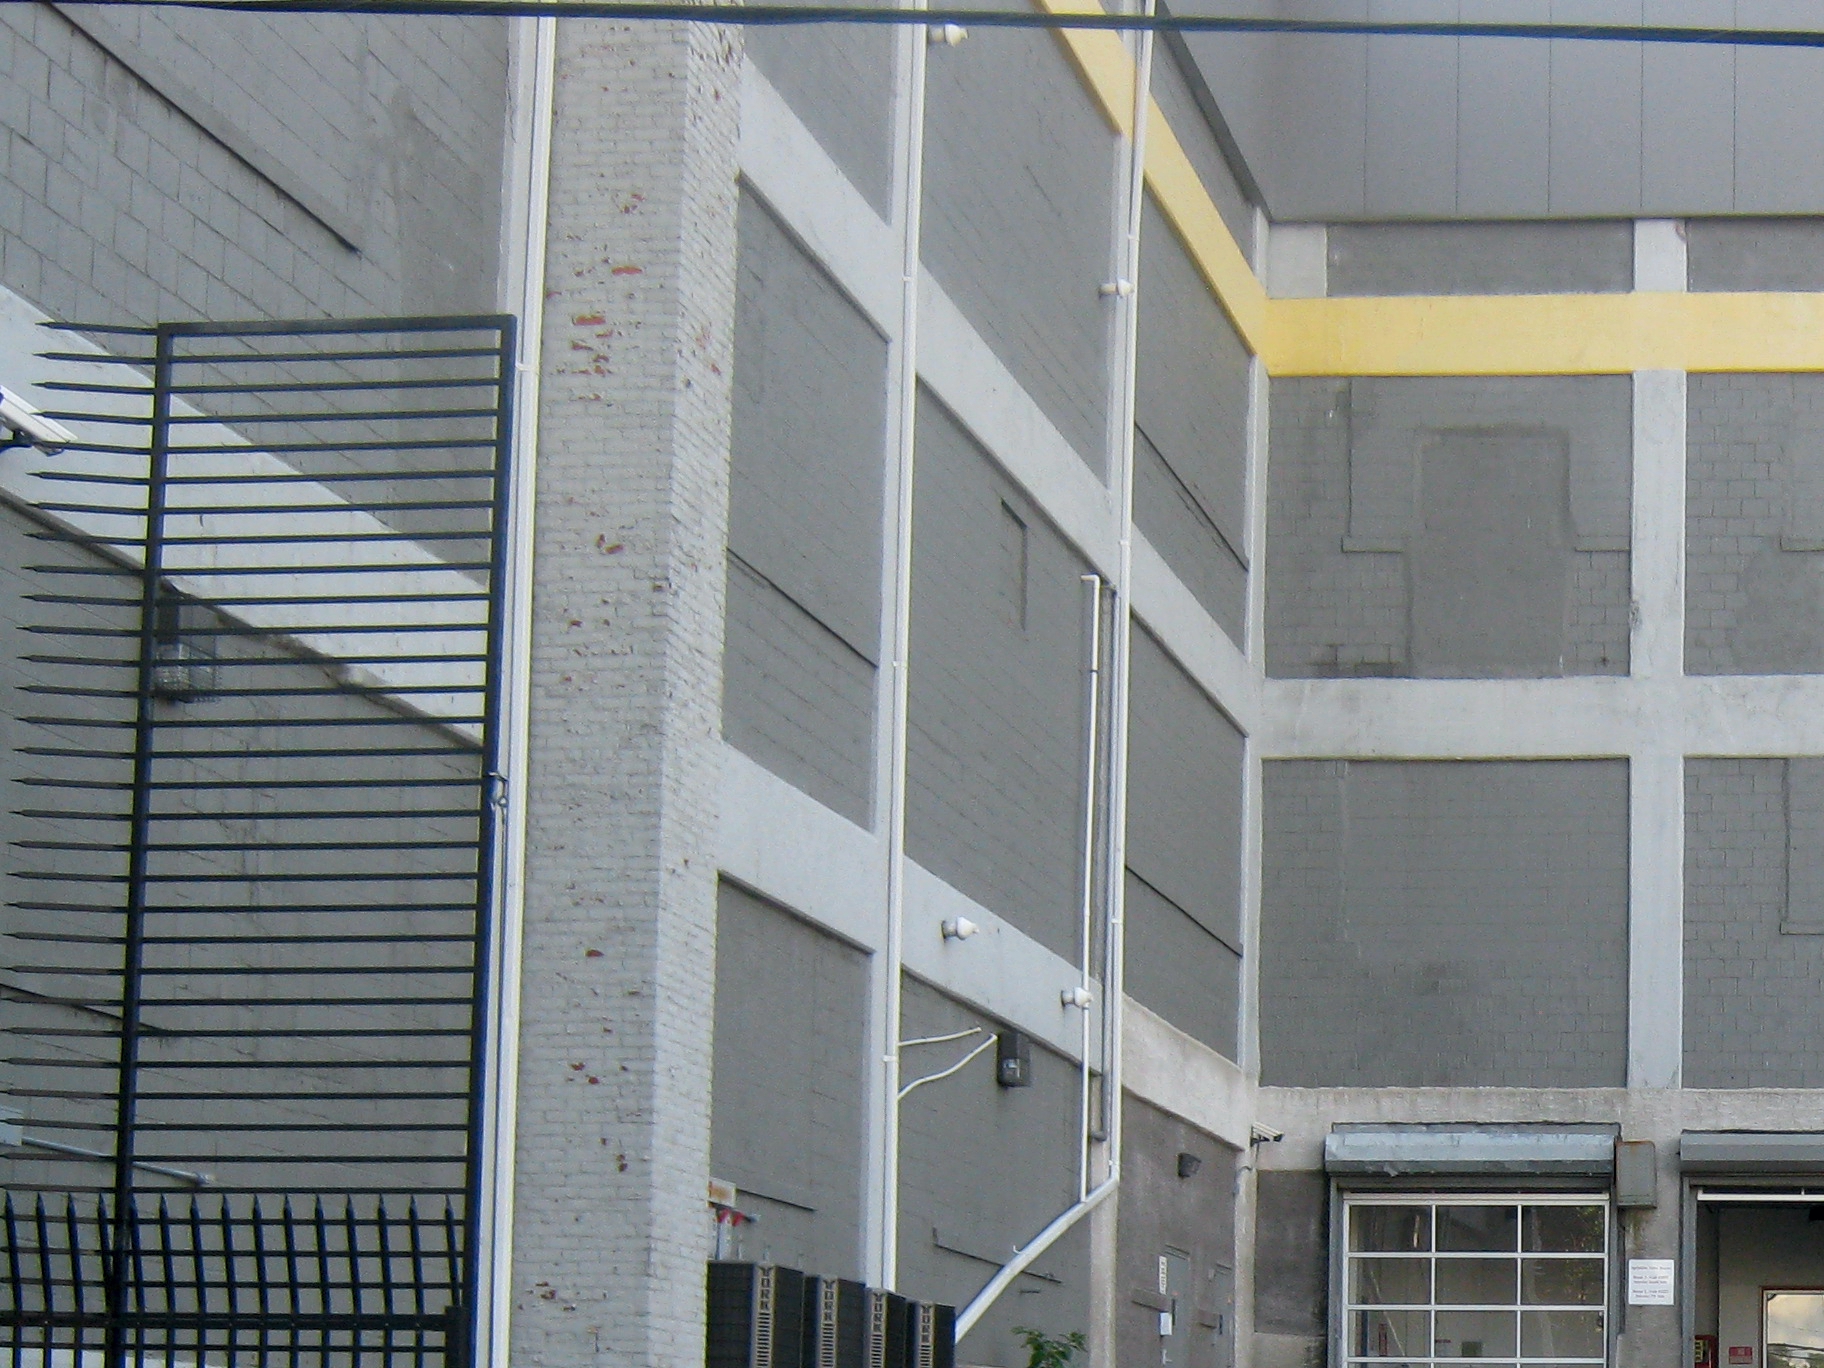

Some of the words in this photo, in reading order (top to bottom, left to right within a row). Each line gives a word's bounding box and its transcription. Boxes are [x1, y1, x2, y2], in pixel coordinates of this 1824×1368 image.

[759, 1266, 773, 1311] YORK
[823, 1280, 835, 1321] YORK
[873, 1293, 883, 1333] YORK
[920, 1305, 932, 1344] YORK
